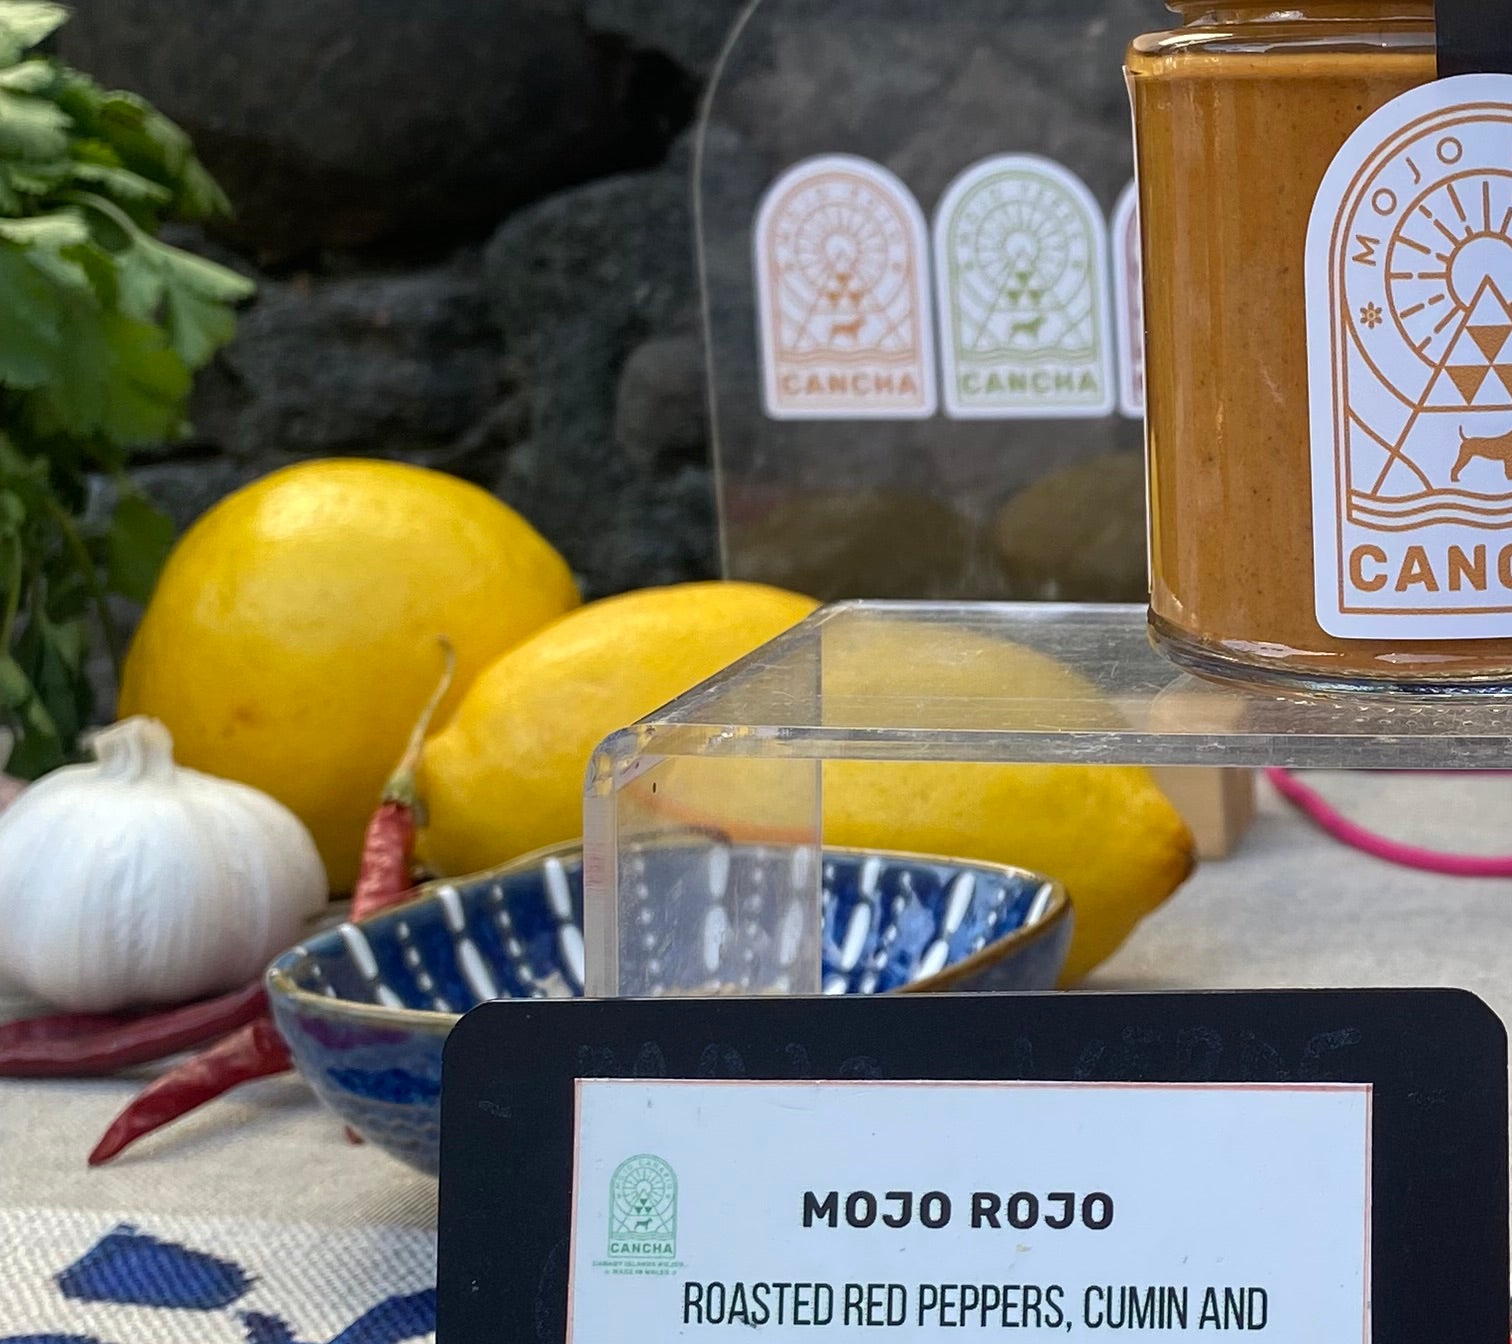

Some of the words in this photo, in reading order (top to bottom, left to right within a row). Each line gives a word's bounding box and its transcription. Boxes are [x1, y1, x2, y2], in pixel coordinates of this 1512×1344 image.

[1352, 137, 1463, 266] MOJO
[781, 372, 918, 396] CANCHA
[961, 371, 1098, 394] CANCHA
[802, 1191, 951, 1229] MOJO
[971, 1192, 1115, 1230] ROJO
[610, 1242, 673, 1254] CANCHA
[683, 1281, 834, 1326] ROASTED
[844, 1283, 907, 1327] RED
[918, 1284, 1073, 1333] PEPPERS,
[1084, 1285, 1188, 1329] CUMIN
[1199, 1286, 1268, 1330] AND
